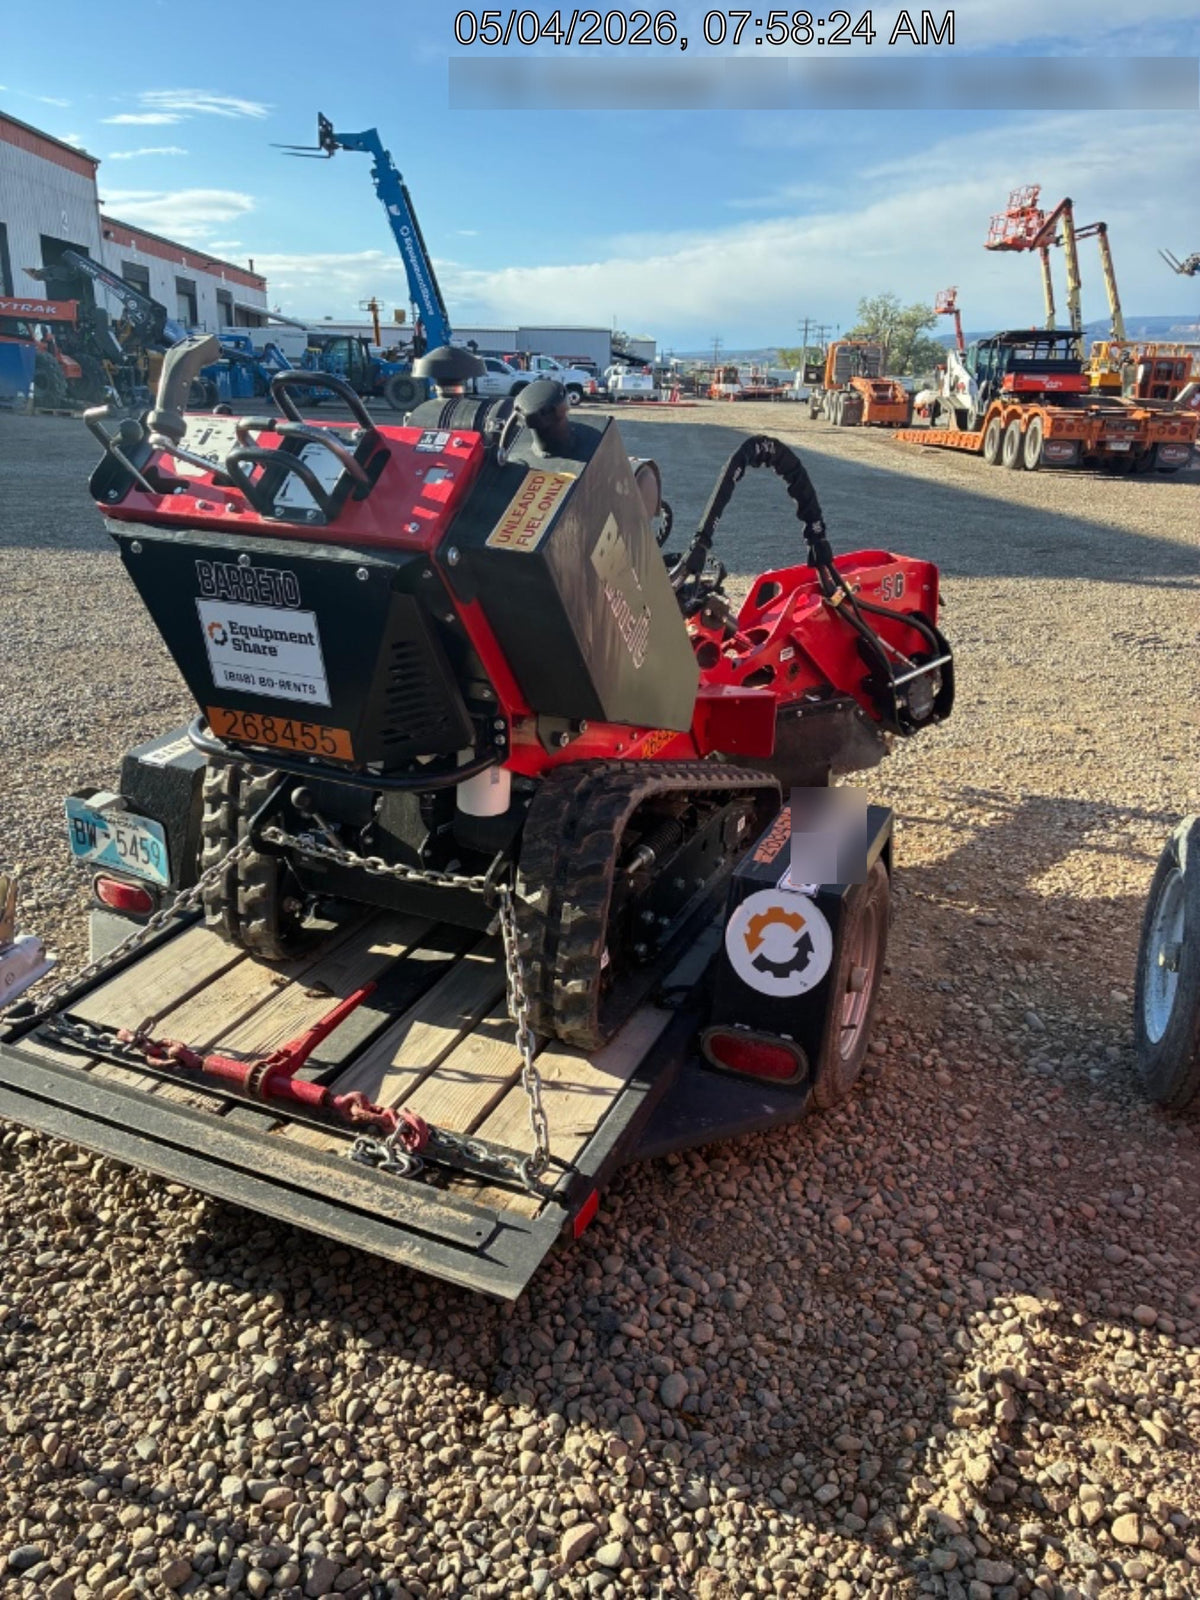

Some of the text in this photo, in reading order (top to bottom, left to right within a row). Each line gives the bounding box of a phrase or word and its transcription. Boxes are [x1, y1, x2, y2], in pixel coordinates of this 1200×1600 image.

[497, 475, 545, 543] UNLEADED
[516, 477, 565, 546] FUEL ONLY
[195, 560, 300, 608] BARRETO
[228, 620, 315, 646] Equipment
[232, 639, 278, 656] Share
[259, 676, 317, 695] 80-RENTS
[223, 711, 337, 754] 268455
